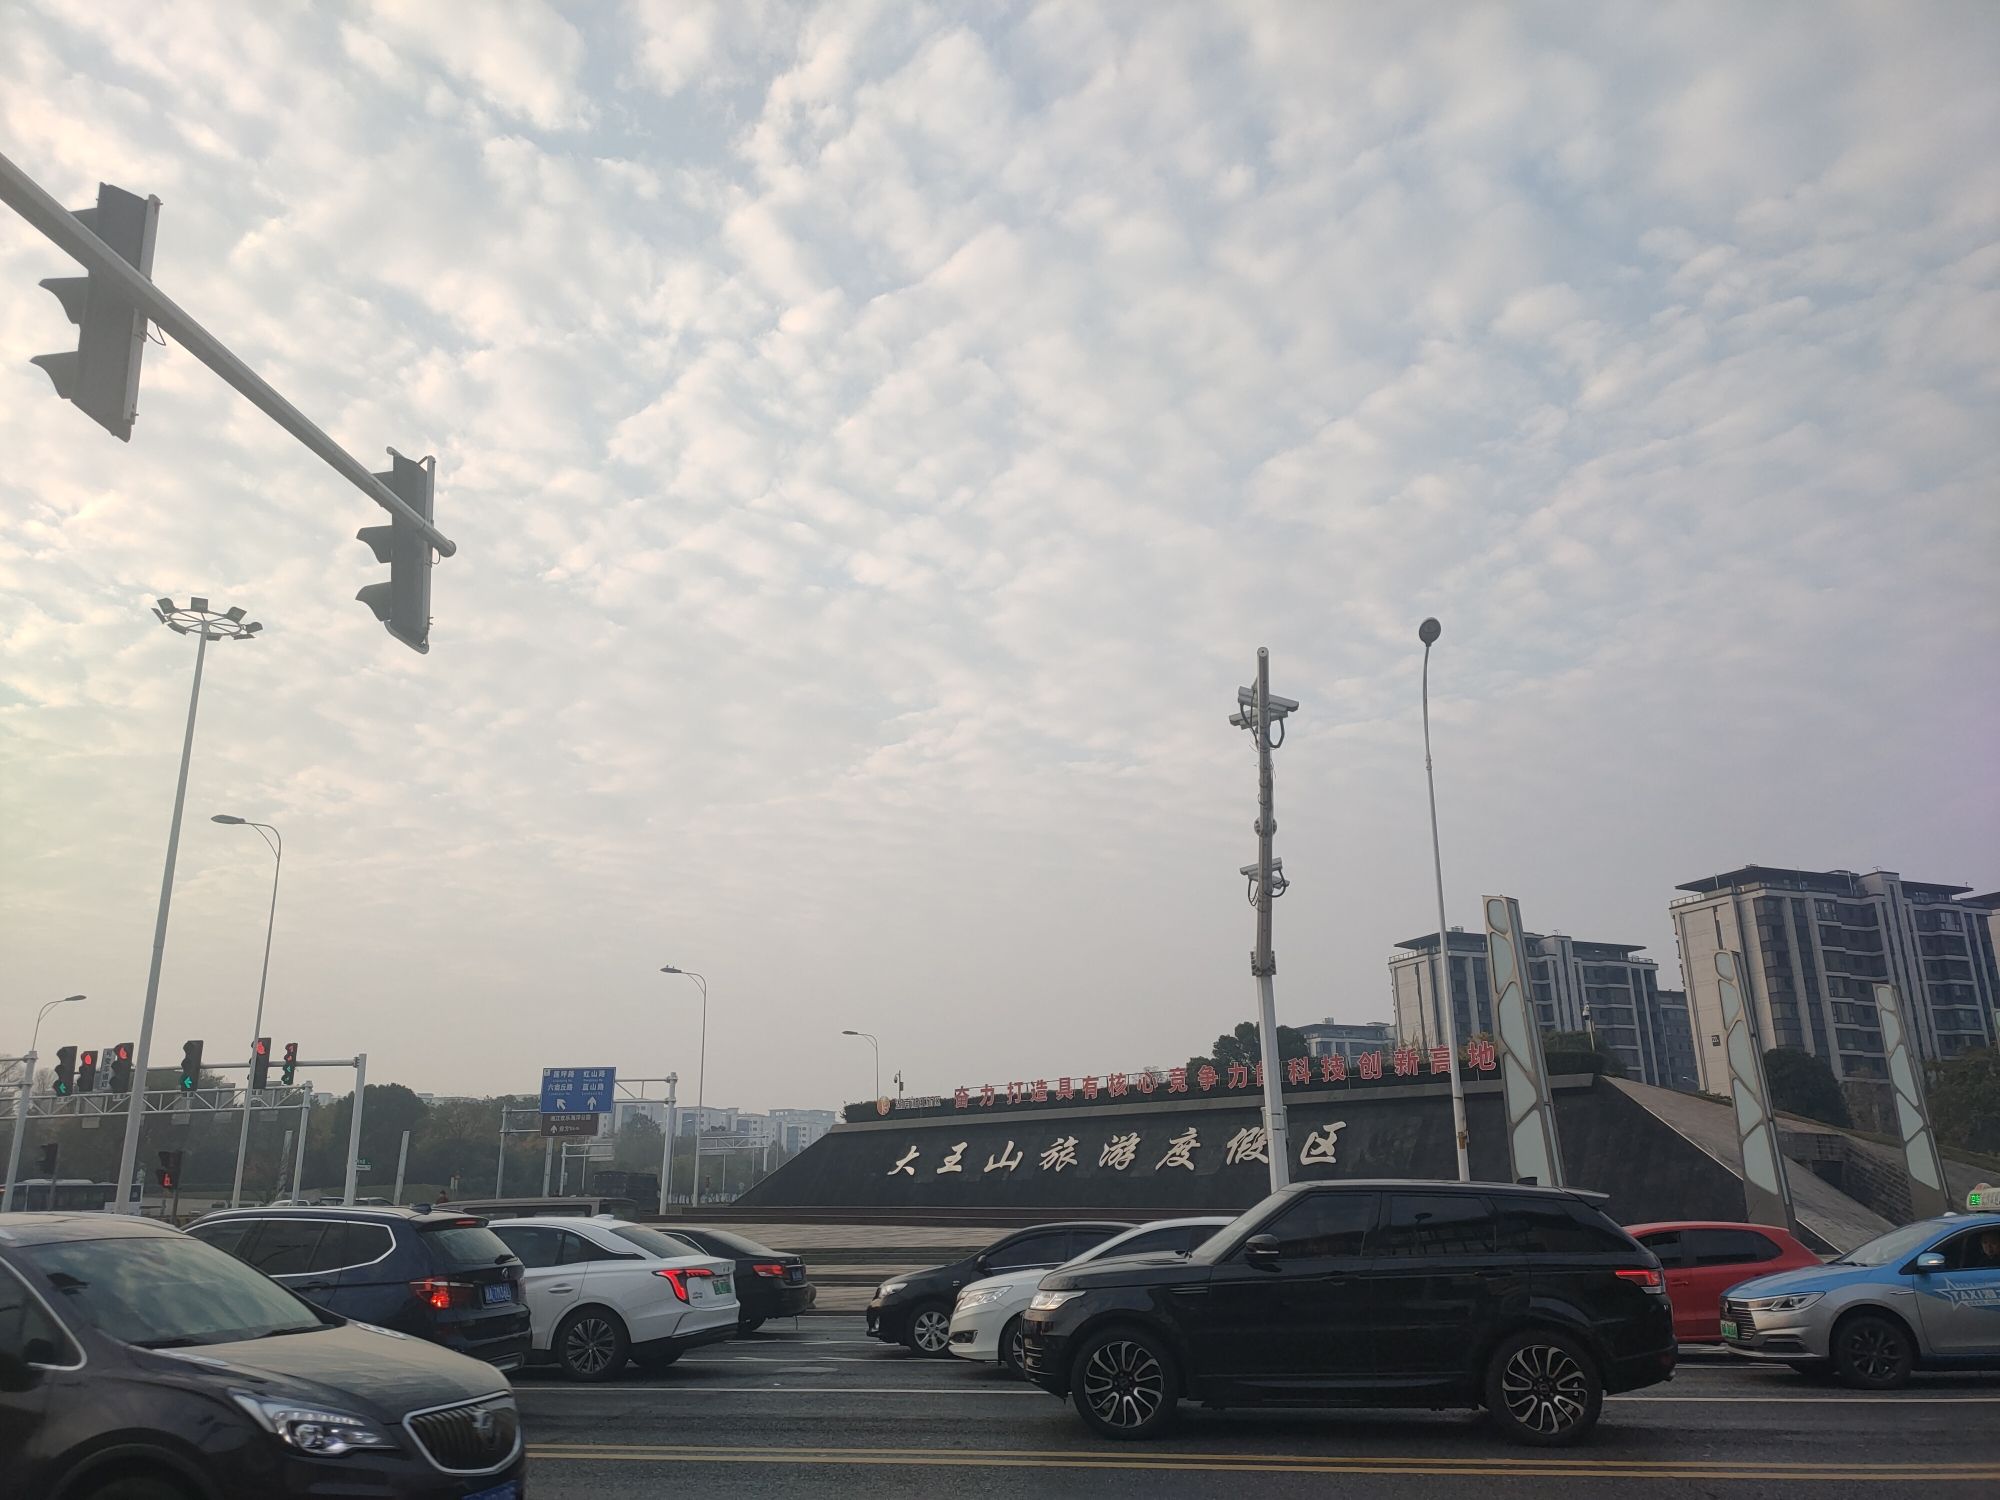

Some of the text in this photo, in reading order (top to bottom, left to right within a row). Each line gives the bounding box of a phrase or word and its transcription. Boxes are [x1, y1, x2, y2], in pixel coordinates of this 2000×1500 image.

[887, 1121, 1347, 1176] 大王山旅游度假区
